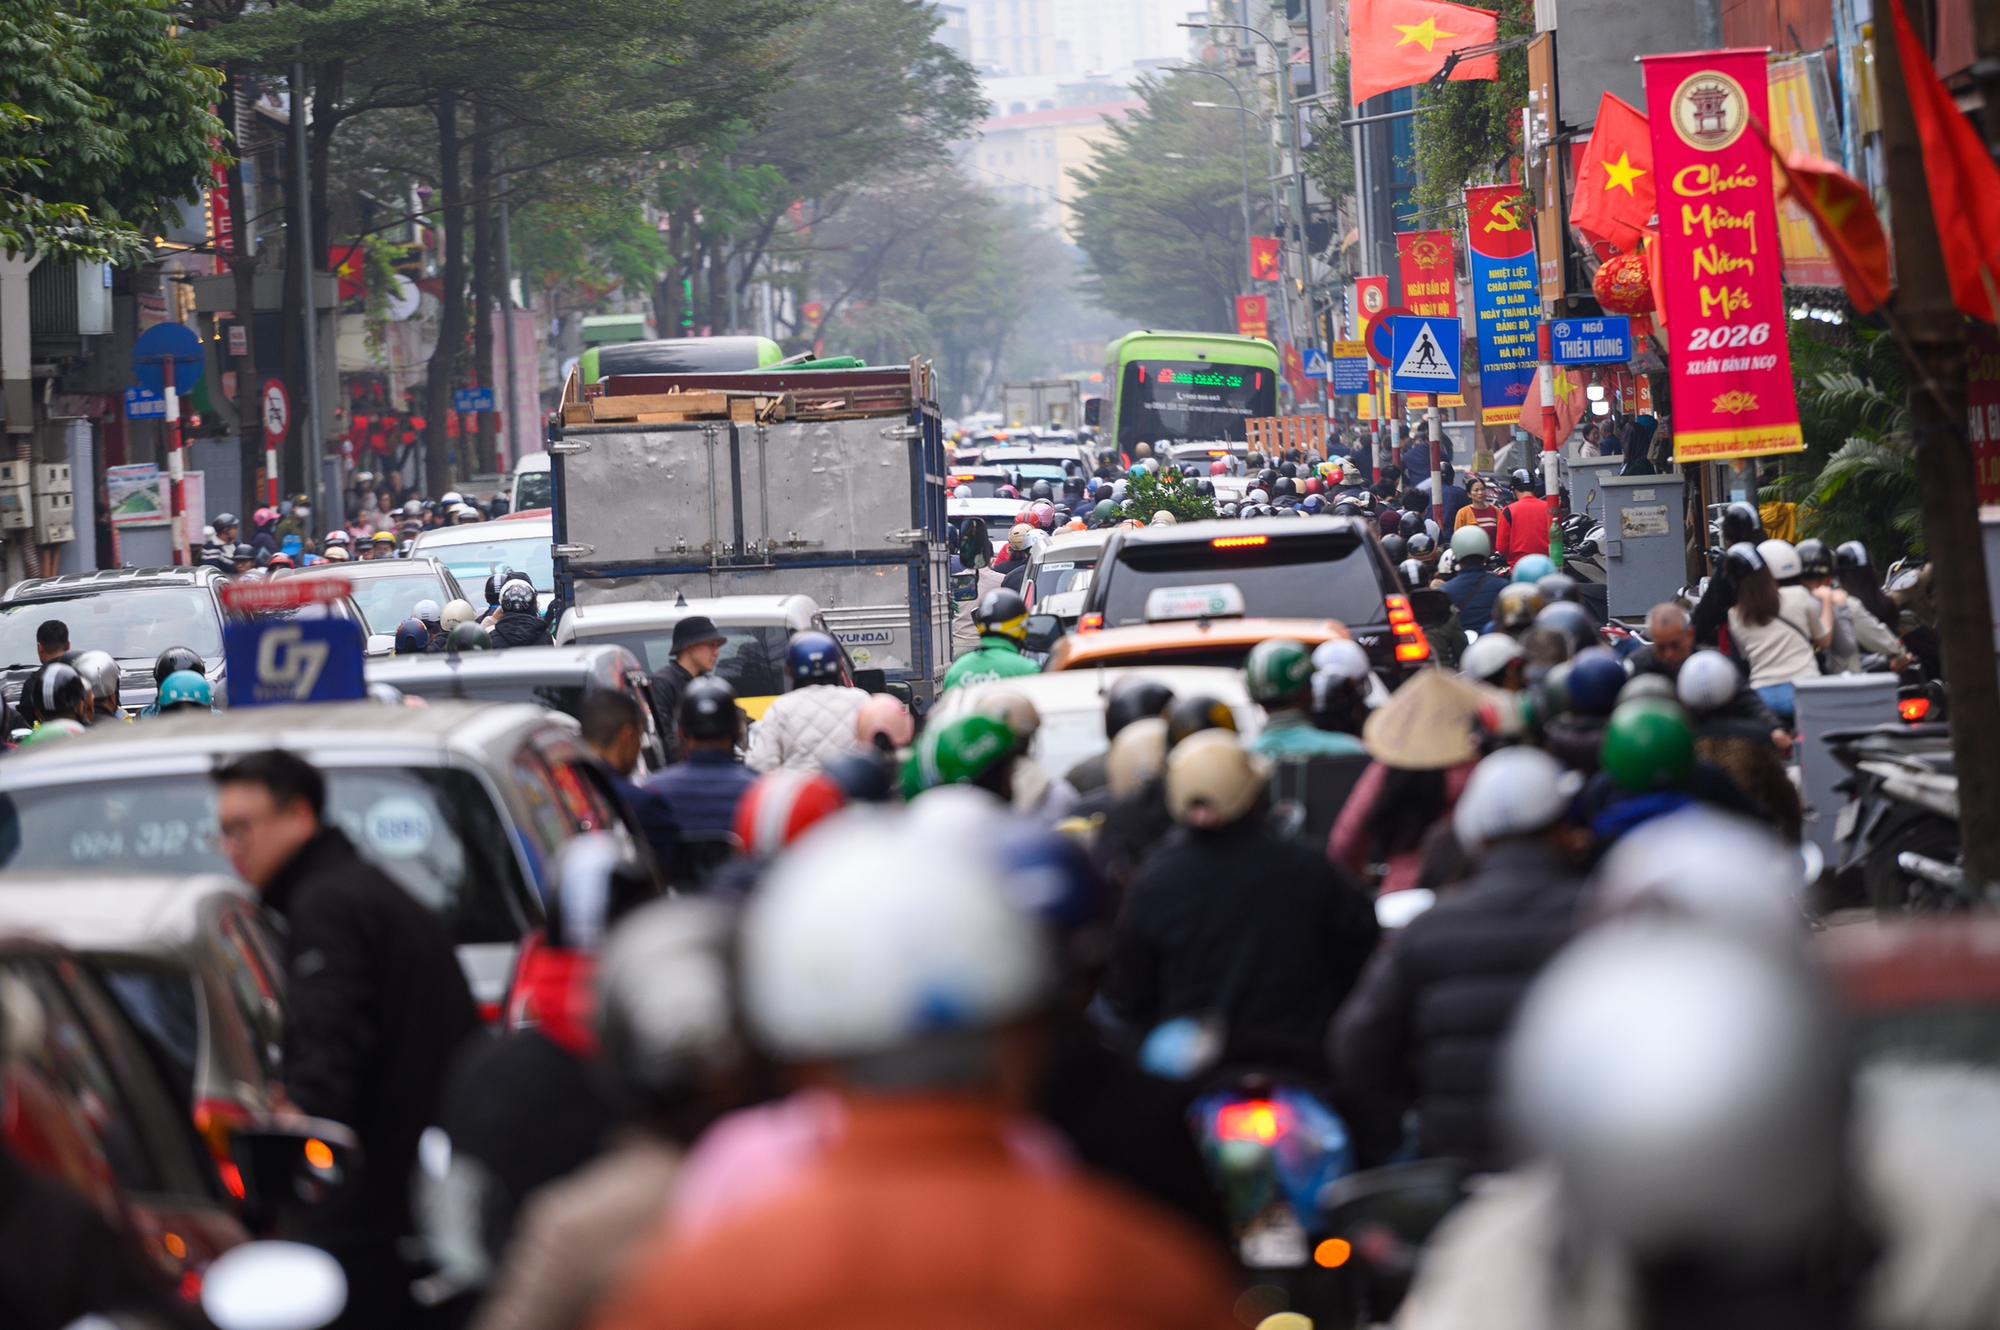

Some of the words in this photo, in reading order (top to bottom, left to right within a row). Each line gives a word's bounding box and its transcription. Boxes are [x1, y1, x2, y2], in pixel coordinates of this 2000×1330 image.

[1672, 163, 1758, 197] Chúc
[1681, 203, 1758, 254] Mừng
[1693, 243, 1754, 281] Năm
[1489, 267, 1510, 279] NHIỆT
[1512, 266, 1527, 278] LIỆT
[1407, 280, 1425, 296] NGÀY
[1487, 281, 1508, 292] CHÀO
[1509, 279, 1532, 290] MỪNG
[1507, 293, 1525, 304] NĂM
[1699, 285, 1752, 320] Mới
[1480, 308, 1500, 320] NGÀY
[1502, 306, 1527, 318] THÀNH
[1496, 319, 1517, 332] ĐẢNG
[1518, 318, 1529, 331] BỘ
[1582, 319, 1604, 333] NGÕ
[1493, 333, 1518, 345] THÀNH
[1519, 330, 1535, 343] PHỐ
[1687, 322, 1771, 351] 2026
[1500, 347, 1510, 358] HÀ
[1512, 346, 1525, 358] NỘI
[1559, 336, 1591, 359] THIÊN
[1686, 356, 1720, 375] XUÂN
[1721, 355, 1750, 373] BÍNH
[1751, 353, 1777, 371] NGỌ
[838, 632, 889, 643] YUNDAI
[257, 626, 330, 701] G7
